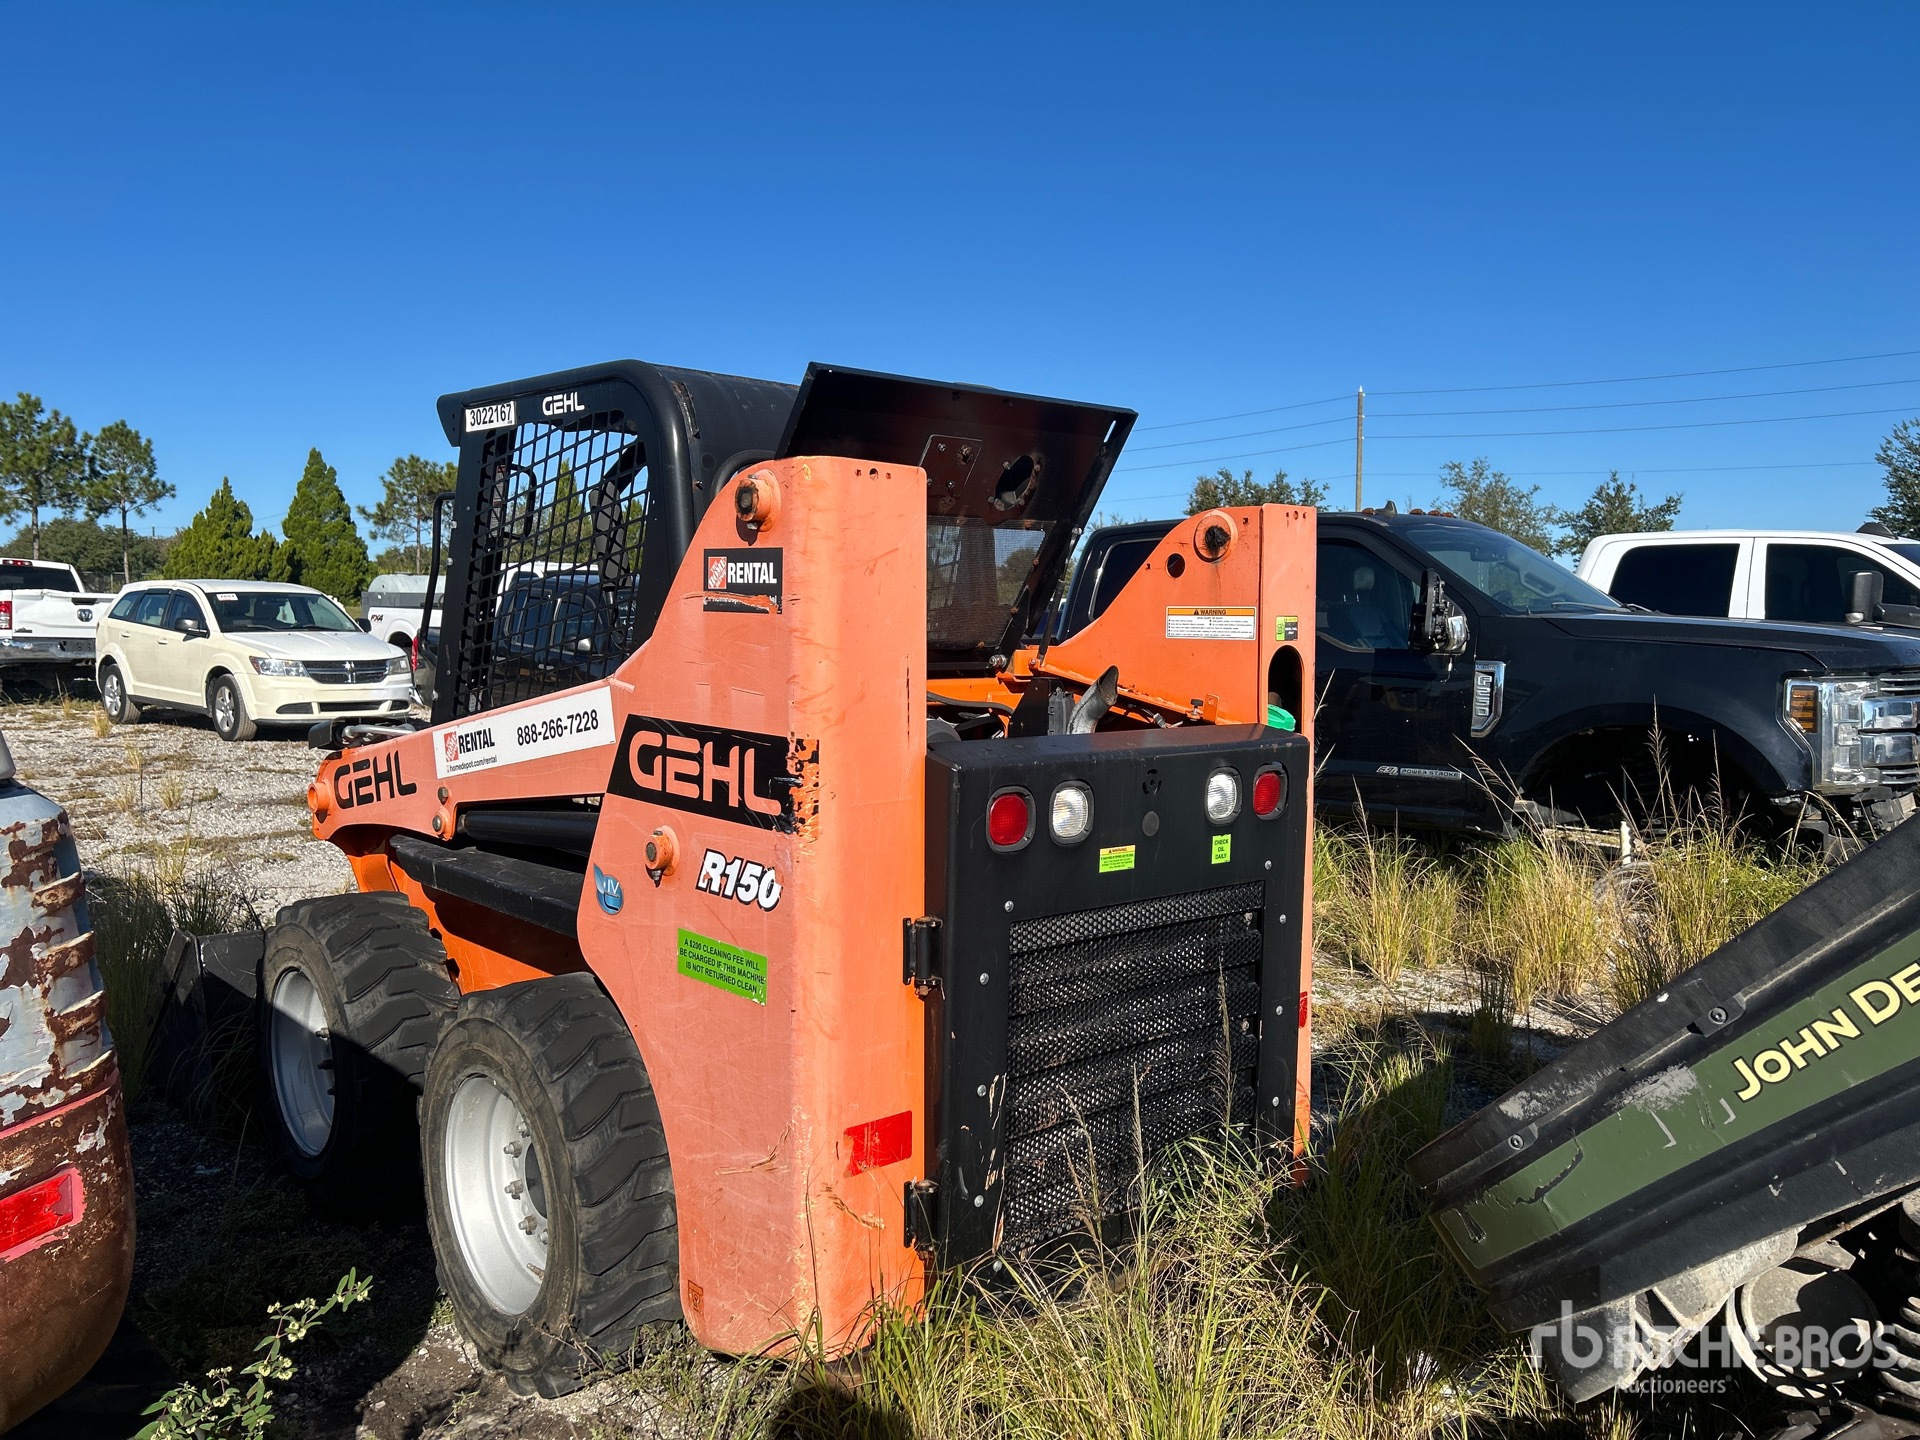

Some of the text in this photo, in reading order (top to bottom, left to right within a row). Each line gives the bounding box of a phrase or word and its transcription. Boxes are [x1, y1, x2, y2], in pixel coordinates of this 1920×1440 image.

[470, 404, 512, 426] 3022167
[542, 392, 585, 416] GEHL
[728, 562, 778, 584] RENTAL
[458, 728, 496, 754] RENTAL
[517, 708, 599, 746] 888-266-7228
[450, 755, 497, 772] homedepot.com/rental
[628, 730, 782, 816] GEHL
[334, 750, 417, 810] GEHL
[696, 849, 784, 910] R150
[680, 948, 766, 984] BE CHARGED IF THIS MACHINE
[684, 938, 689, 946] A
[702, 944, 732, 960] CLEANING
[733, 954, 744, 965] FEE
[746, 959, 760, 970] WILL
[692, 963, 704, 973] NOT
[705, 969, 736, 986] RETURNED
[737, 980, 757, 994] CLEAN
[1732, 1007, 1863, 1103] JOHN
